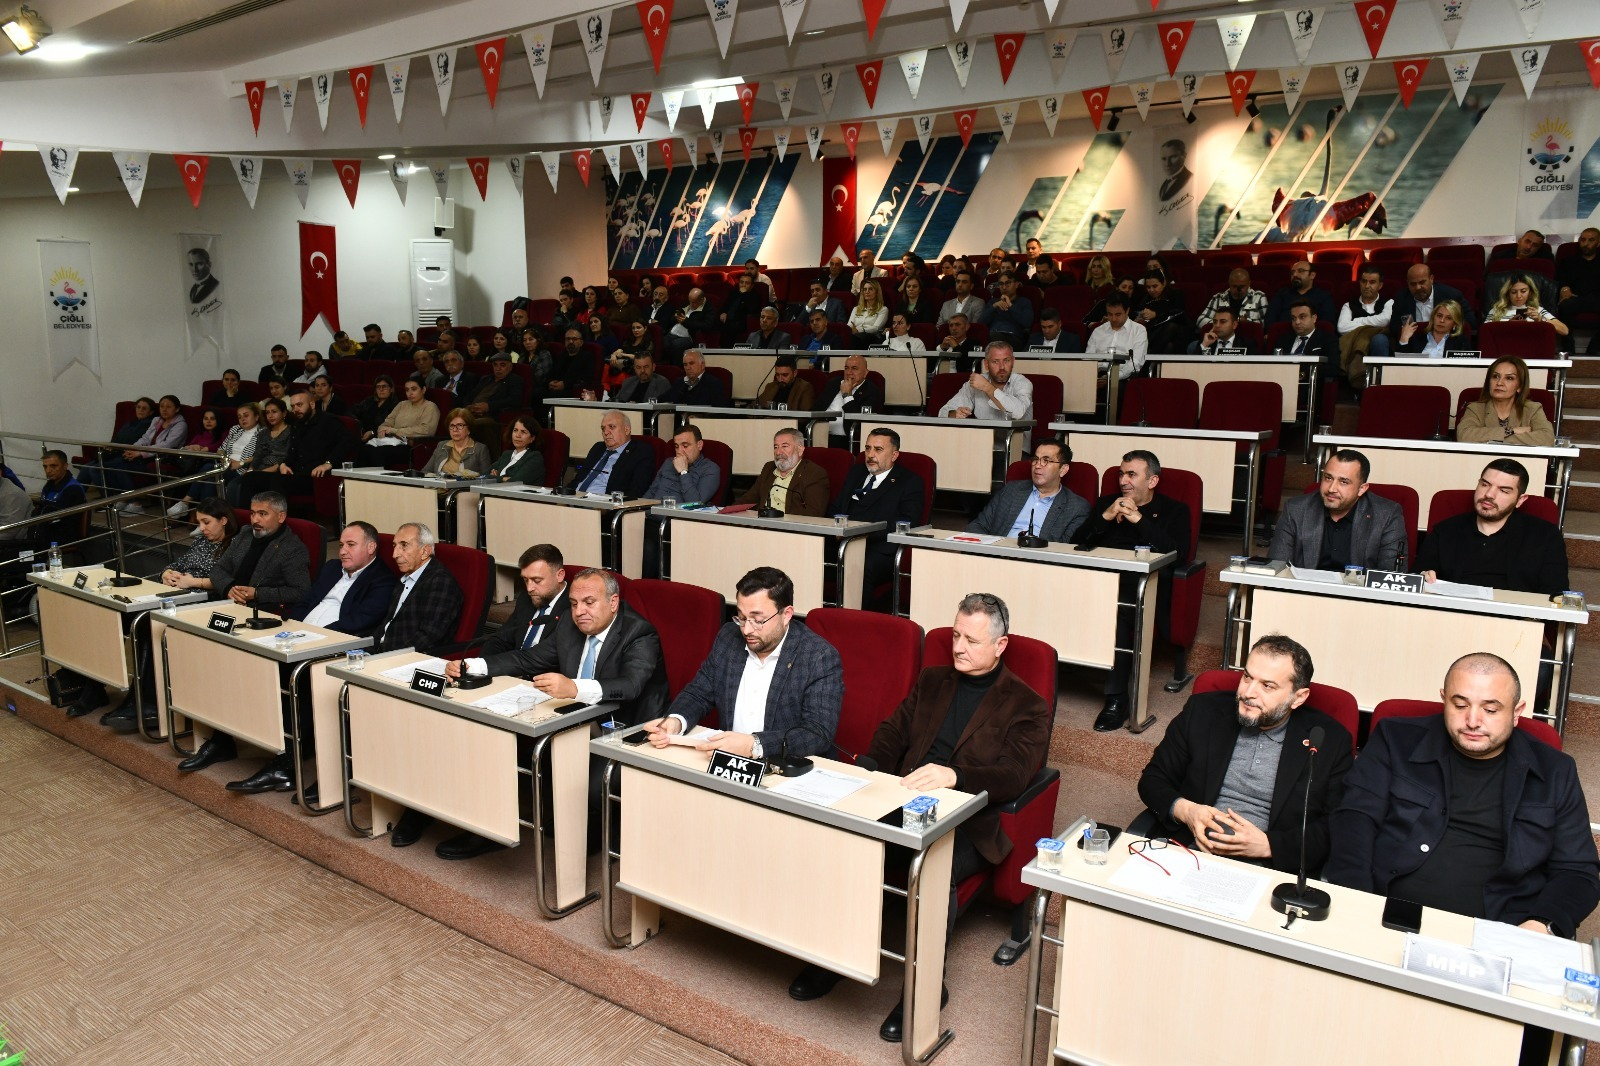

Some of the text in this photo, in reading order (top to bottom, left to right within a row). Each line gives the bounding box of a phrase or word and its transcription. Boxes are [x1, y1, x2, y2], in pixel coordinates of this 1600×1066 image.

[1383, 574, 1407, 583] AK
[1371, 581, 1417, 593] PARTİ
[214, 619, 229, 629] CHP
[418, 678, 439, 690] CHP
[727, 757, 750, 772] AK
[713, 765, 756, 786] PARTİ
[1426, 953, 1486, 978] MHP
